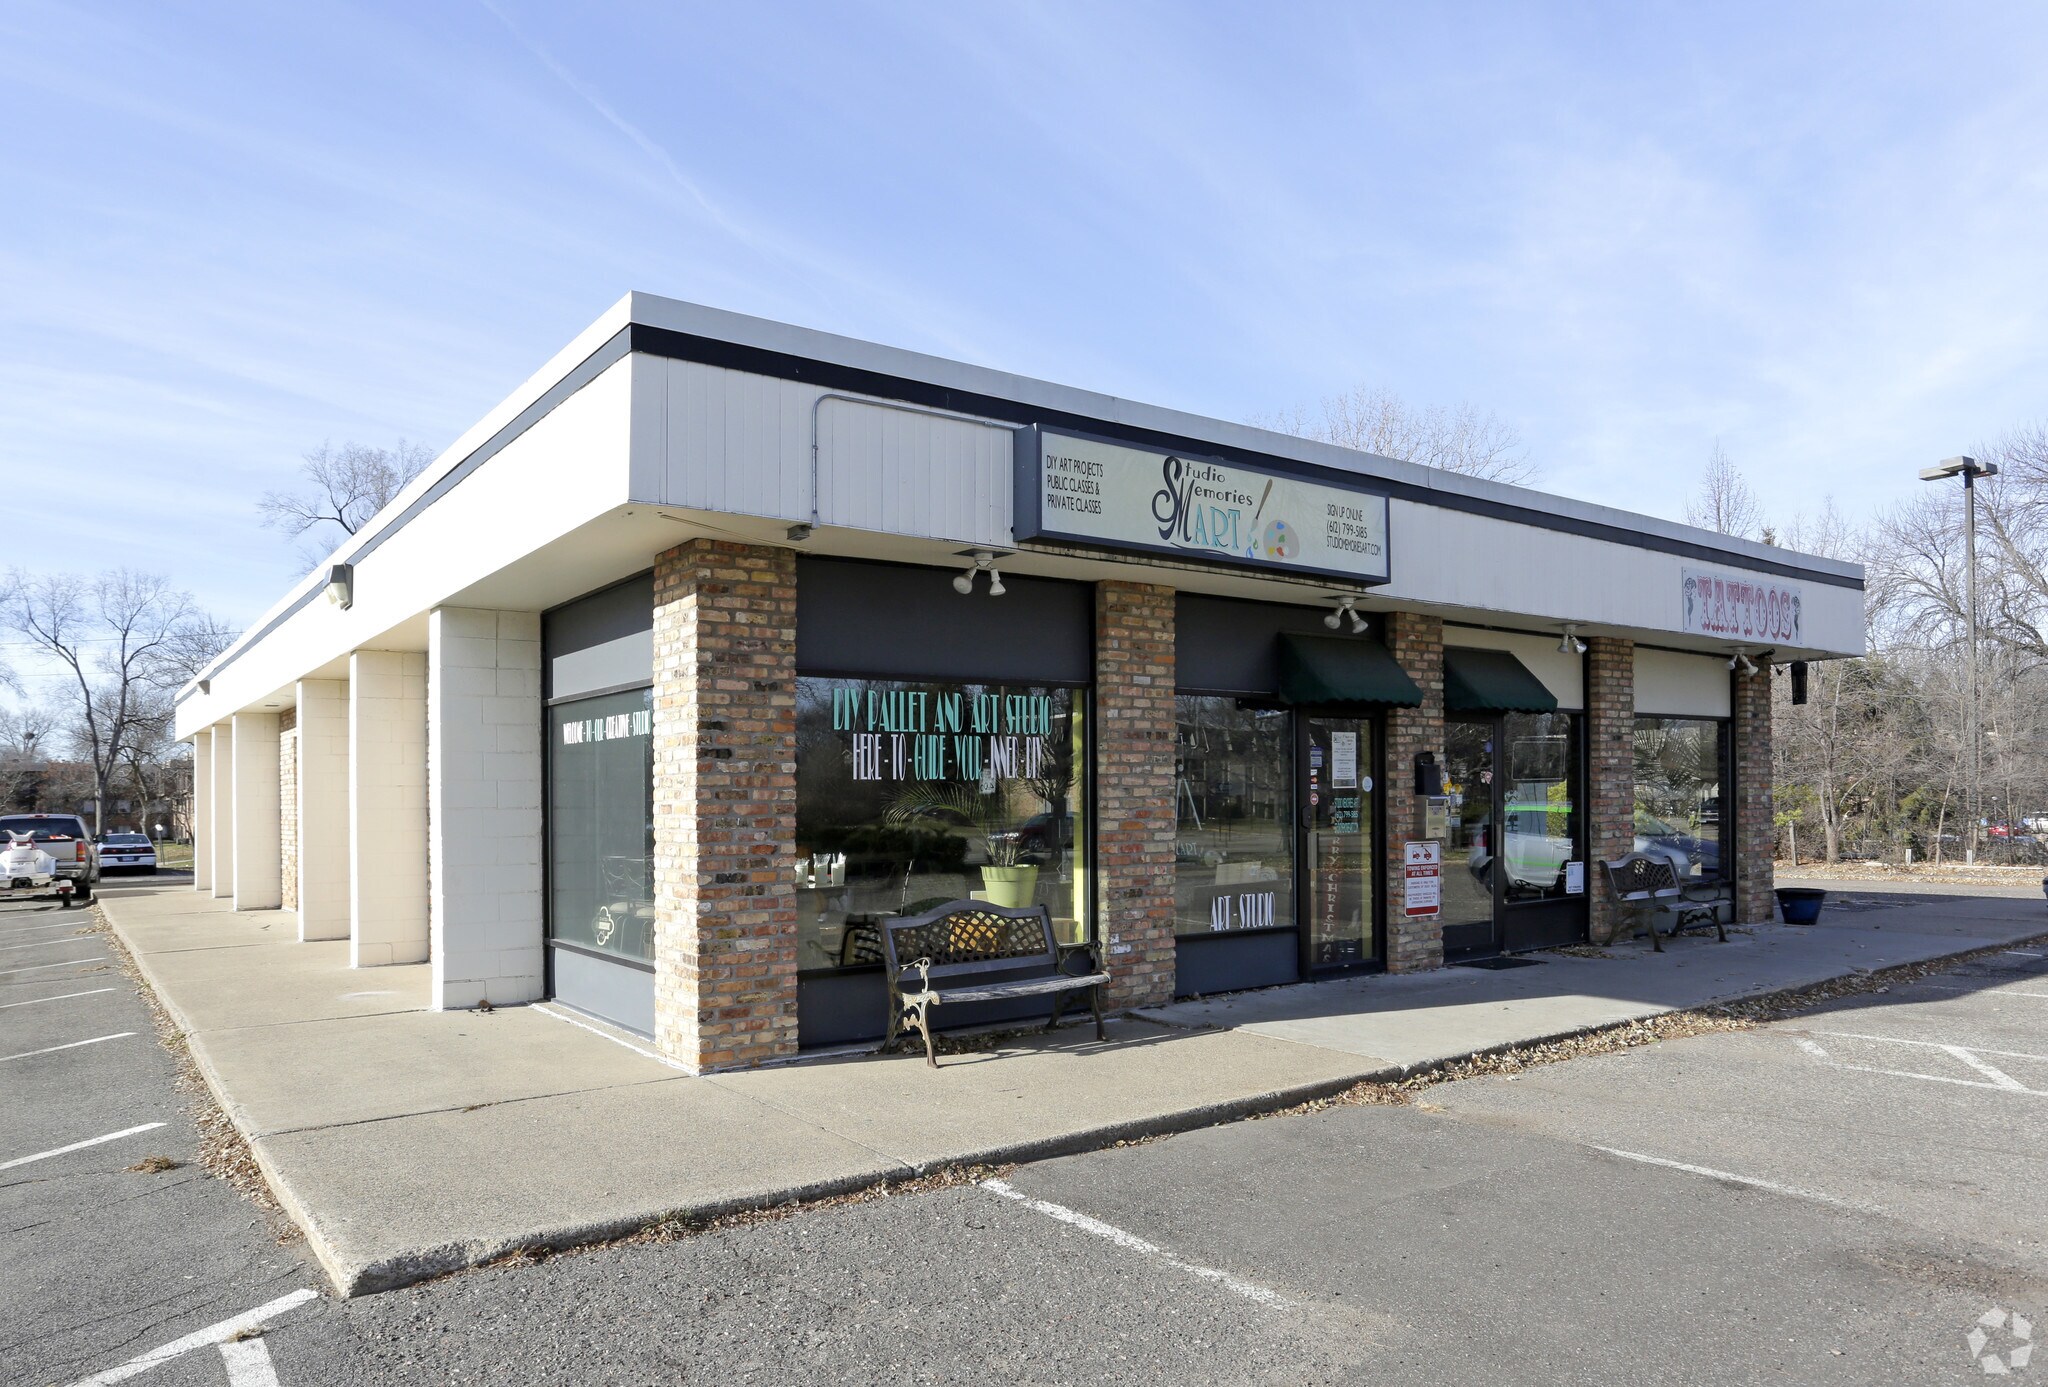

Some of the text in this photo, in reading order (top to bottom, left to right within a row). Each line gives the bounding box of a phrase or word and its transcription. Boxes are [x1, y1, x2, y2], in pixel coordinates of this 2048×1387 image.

[1046, 454, 1104, 479] DIY ART PROJECTS
[1047, 474, 1100, 495] PUBLIC CLASSES &
[1047, 493, 1102, 515] PRIVATE CLASSES
[1327, 503, 1338, 517] SIGN
[1345, 507, 1363, 521] ONLINE
[1193, 503, 1241, 550] ART
[1696, 575, 1792, 640] TATTOOS
[833, 688, 1053, 735] DIY PALLET AND ART STUDIO
[852, 732, 882, 780] HERE
[890, 733, 907, 781] TO
[914, 733, 946, 780] GUIDE
[953, 734, 983, 781] YOUR
[990, 735, 1019, 779] INNER
[1025, 736, 1043, 779] DIY
[1209, 891, 1276, 932] ART STUDIO
